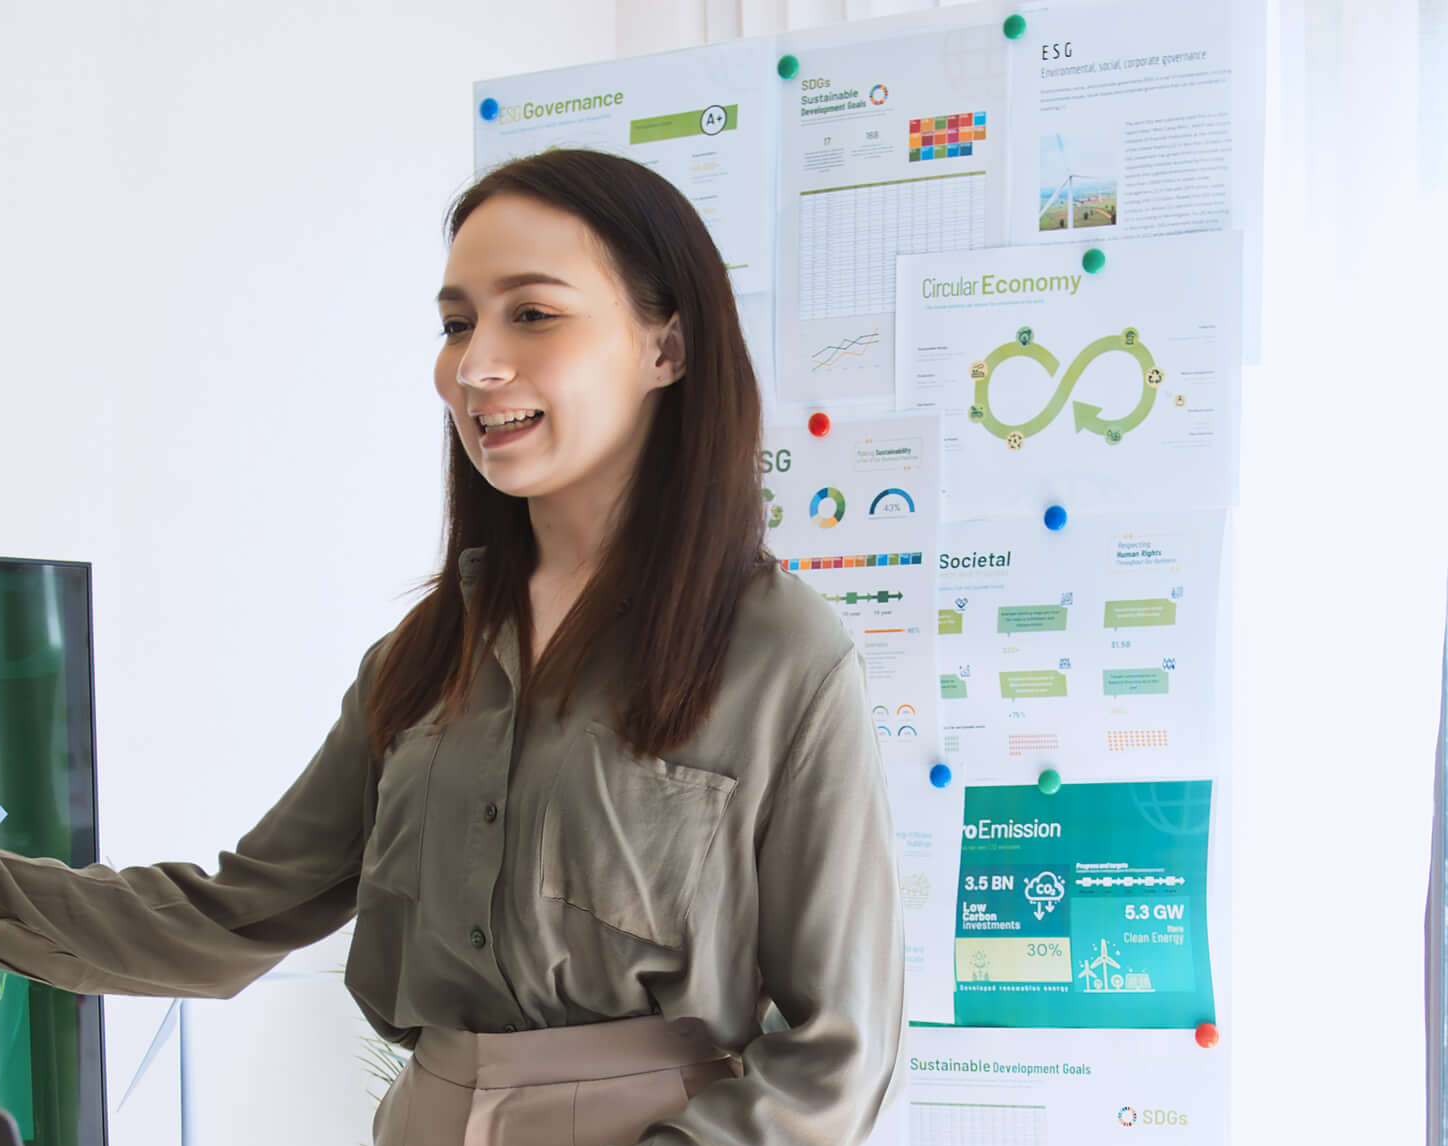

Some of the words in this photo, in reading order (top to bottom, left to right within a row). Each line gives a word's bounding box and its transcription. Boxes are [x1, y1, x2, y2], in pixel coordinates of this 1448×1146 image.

[1041, 42, 1072, 60] ESG
[1162, 50, 1207, 66] governance
[801, 77, 831, 91] SDGs
[801, 88, 859, 105] Sustainable
[523, 91, 624, 120] Governance
[706, 113, 723, 126] A+
[922, 276, 979, 299] Circular
[982, 274, 1082, 295] Economy
[760, 449, 791, 473] SG
[939, 551, 1011, 569] Societal
[964, 875, 989, 890] 3.5
[991, 875, 1014, 890] BN
[962, 902, 987, 912] Low
[1125, 904, 1150, 920] 5.3
[1154, 904, 1184, 920] GW
[962, 911, 997, 921] Carbon
[962, 920, 1021, 930] Investments
[1123, 932, 1150, 944] Clean
[1152, 931, 1184, 945] Energy
[1026, 943, 1063, 957] 30%
[910, 1057, 991, 1073] Sustainable
[993, 1062, 1060, 1077] Development
[1063, 1063, 1092, 1075] Goals
[1142, 1109, 1189, 1126] SDGs
